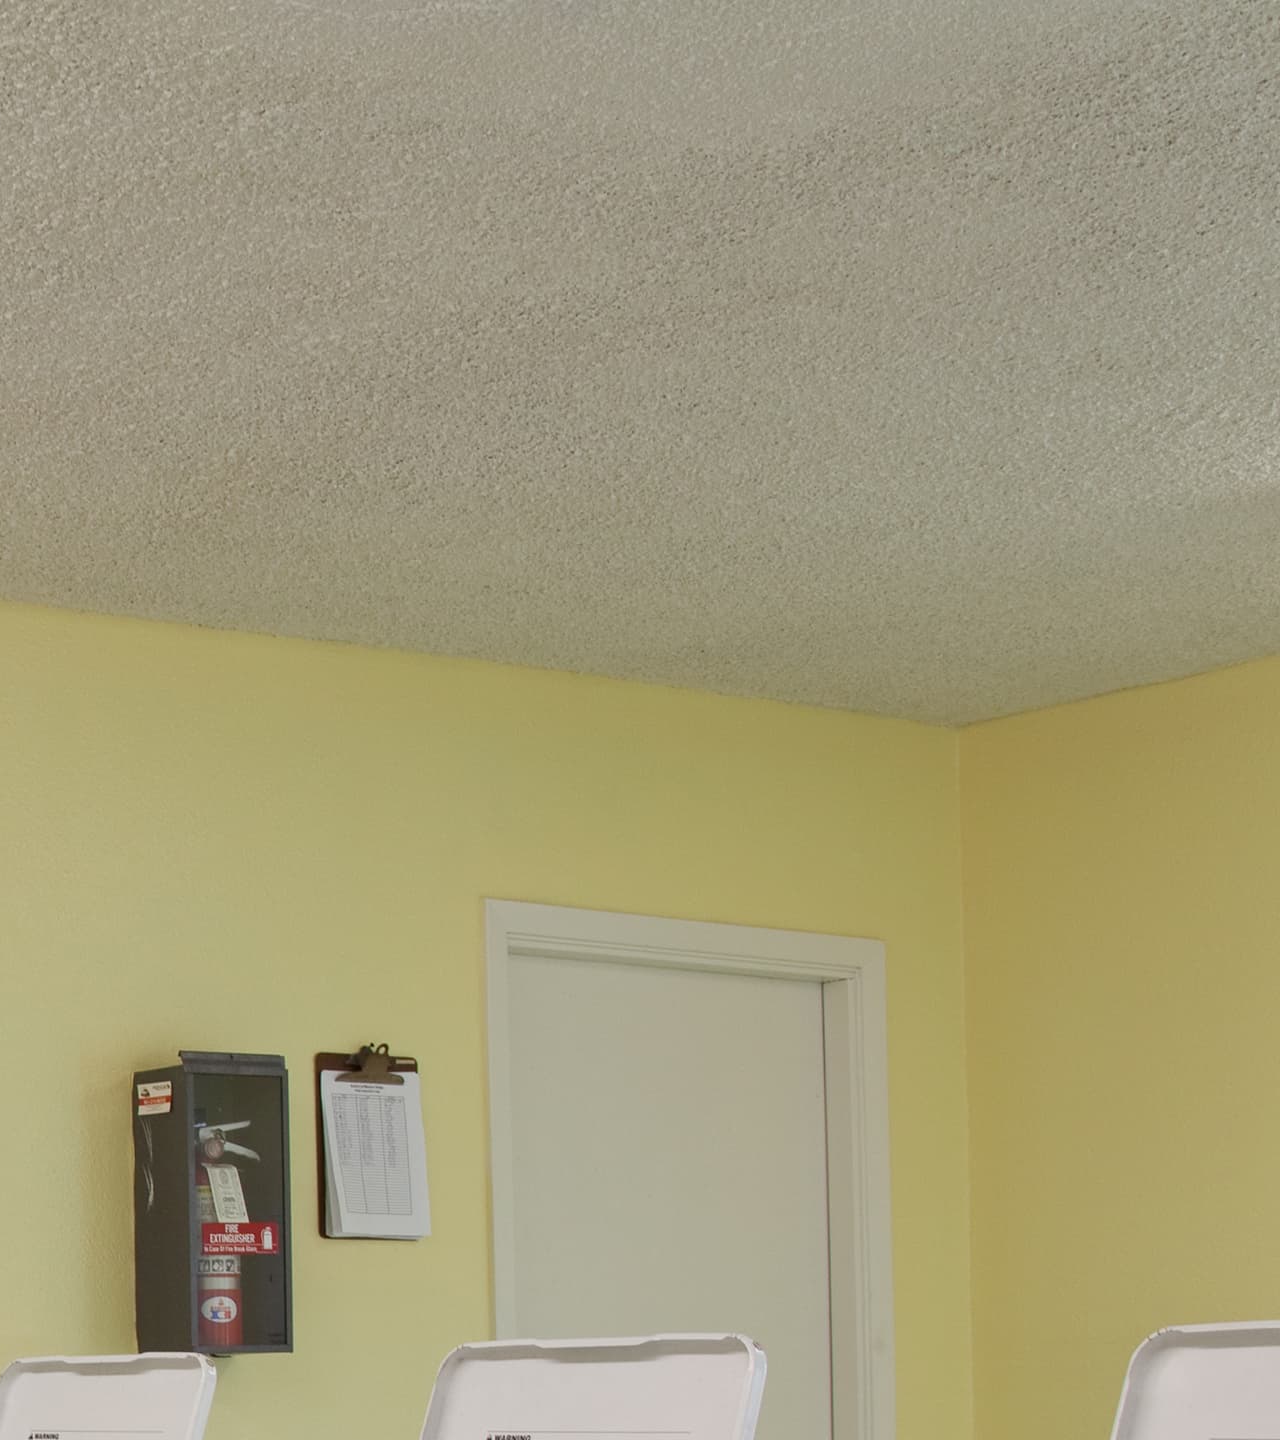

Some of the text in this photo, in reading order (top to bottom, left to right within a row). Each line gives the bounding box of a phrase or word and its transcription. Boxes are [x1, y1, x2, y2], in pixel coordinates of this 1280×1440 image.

[225, 1223, 240, 1233] FIRE
[209, 1233, 256, 1244] EXTINGUISHER
[34, 1433, 60, 1440] WARNING
